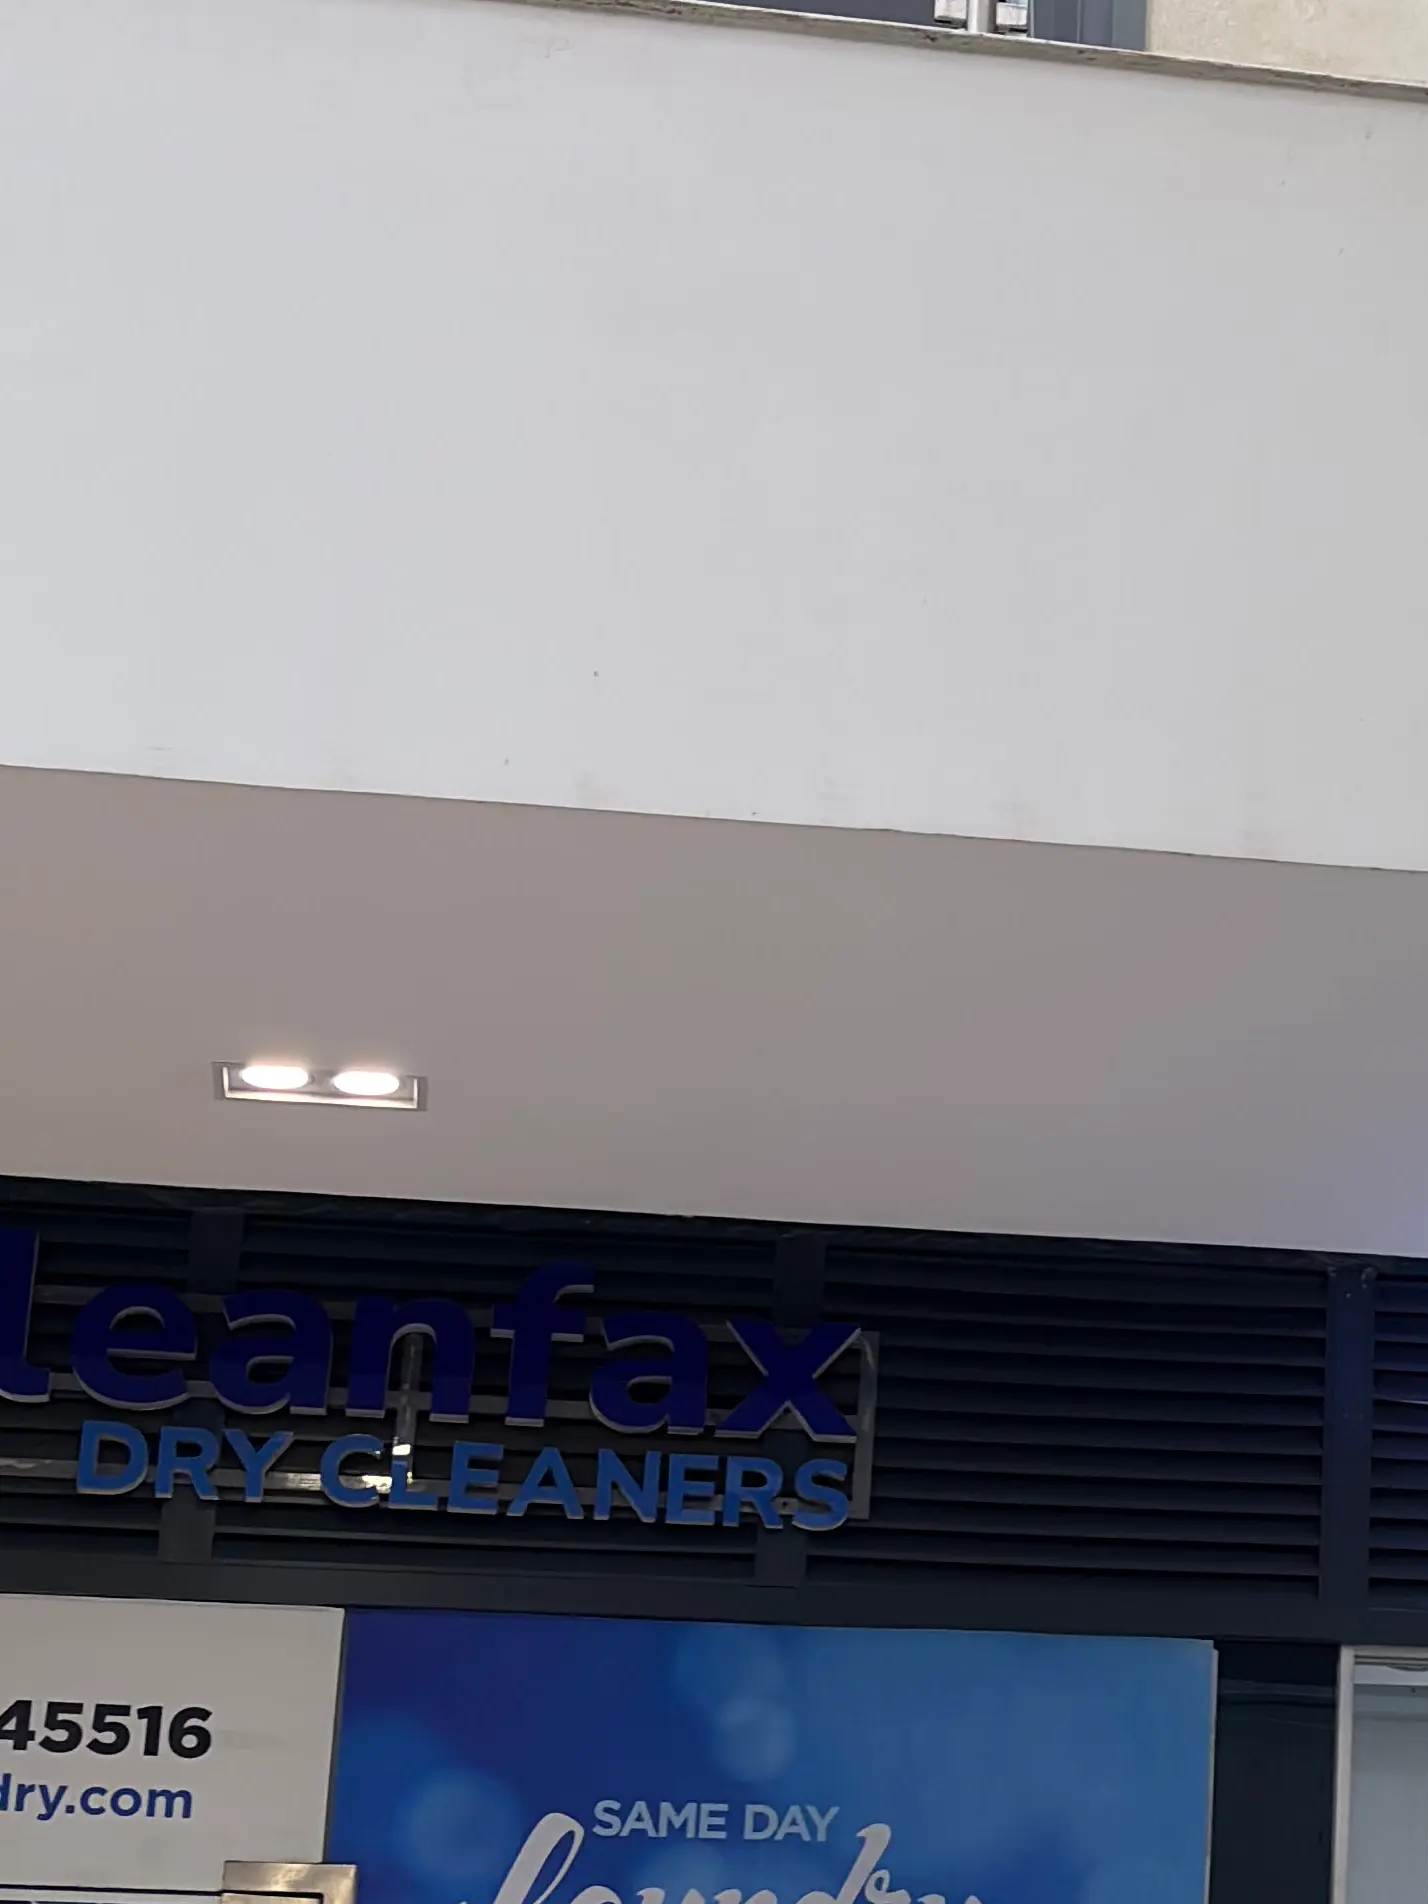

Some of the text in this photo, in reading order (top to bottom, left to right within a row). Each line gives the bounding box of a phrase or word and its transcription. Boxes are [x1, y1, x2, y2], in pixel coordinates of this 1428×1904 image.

[76, 1420, 848, 1531] DRY CLEANERS
[592, 1798, 839, 1843] SAME DAY
